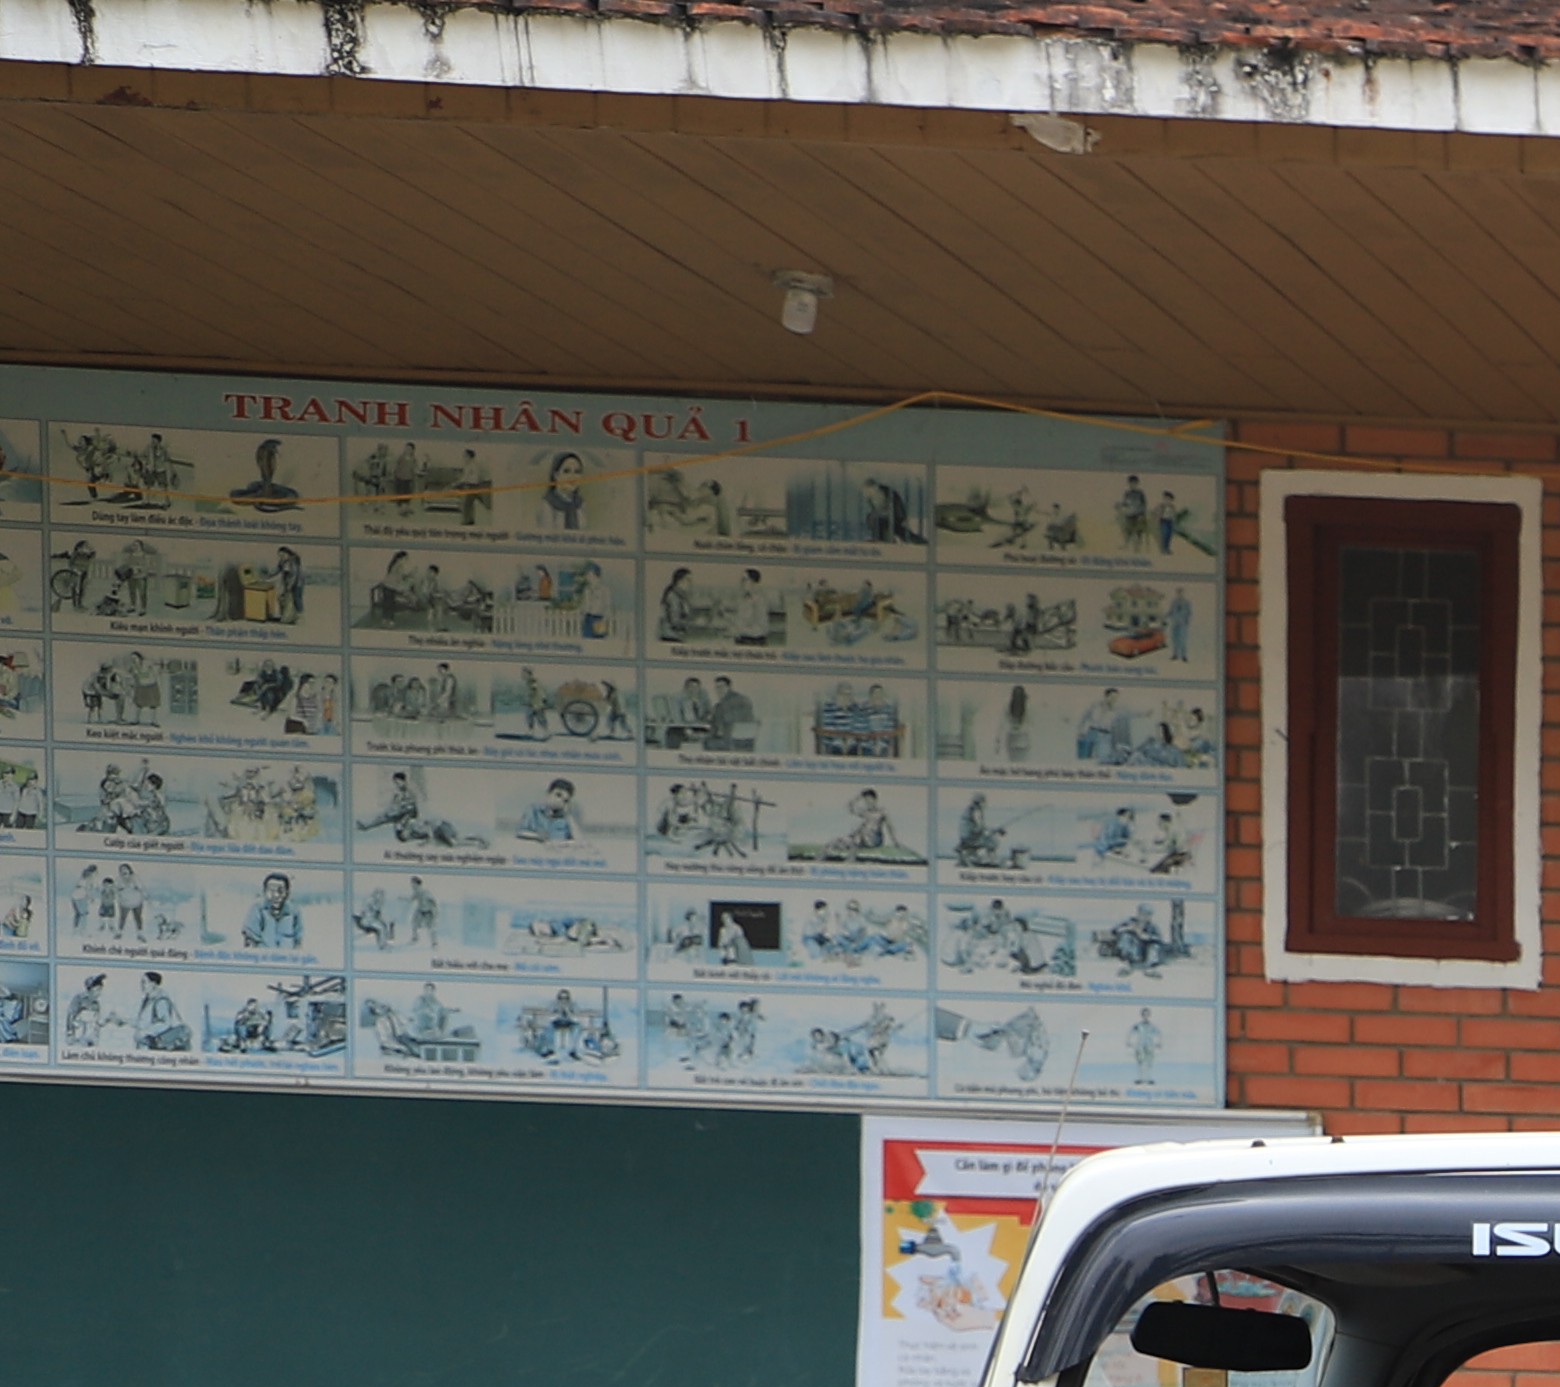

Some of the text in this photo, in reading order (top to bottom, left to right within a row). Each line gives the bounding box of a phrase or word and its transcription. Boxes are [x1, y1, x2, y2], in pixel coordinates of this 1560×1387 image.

[225, 393, 752, 447] TRANH NHÂN QUẢ 1
